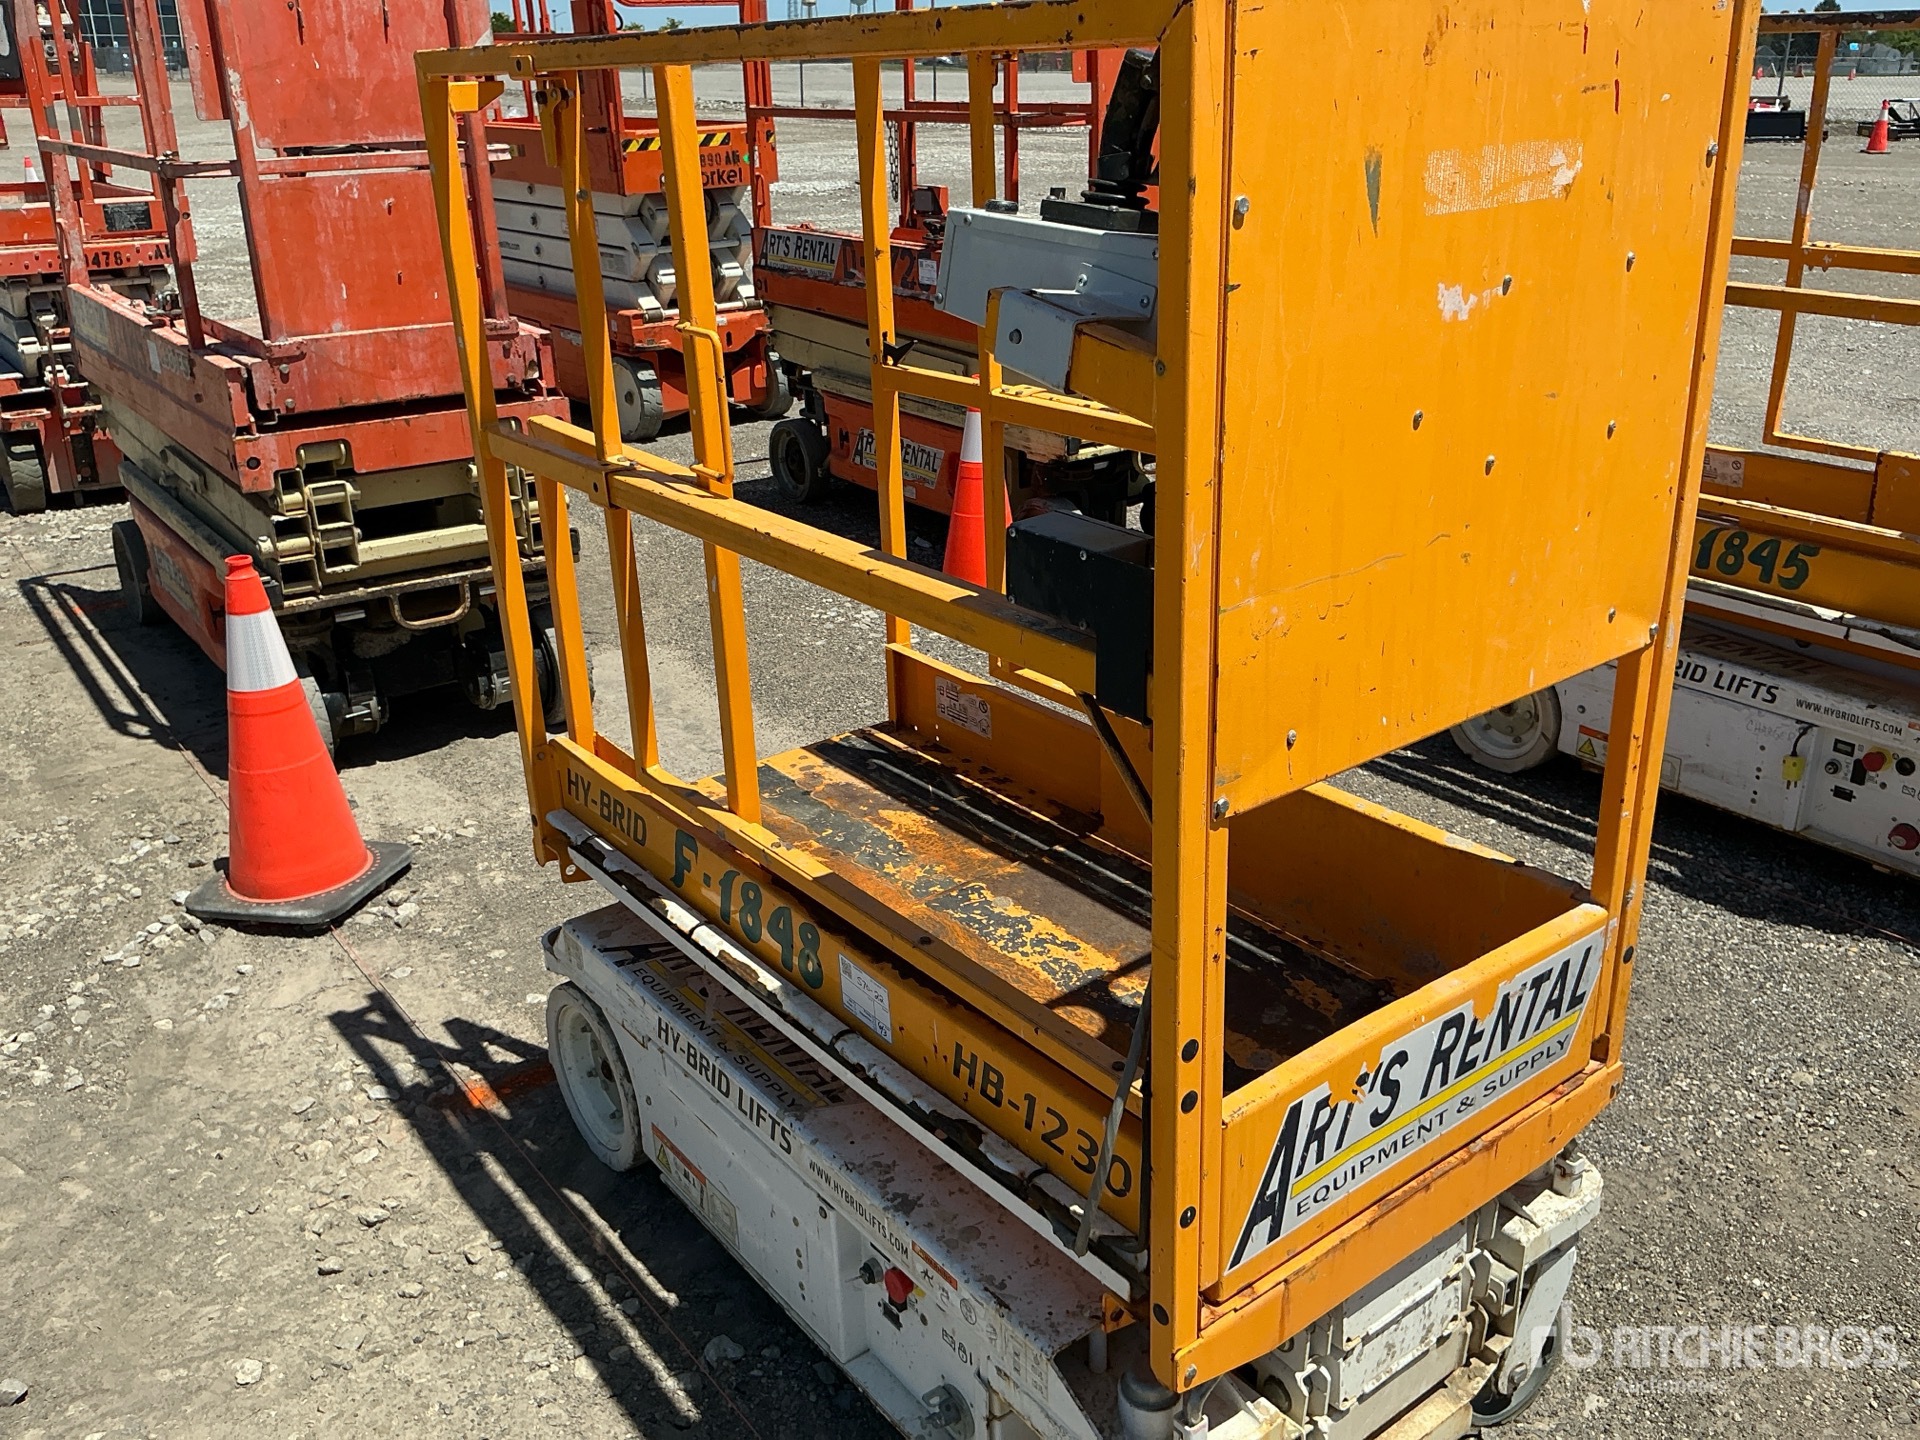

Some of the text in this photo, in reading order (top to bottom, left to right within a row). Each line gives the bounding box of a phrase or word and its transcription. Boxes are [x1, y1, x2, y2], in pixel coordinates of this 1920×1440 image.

[701, 167, 743, 186] orkel
[758, 229, 836, 267] ART'S RENTAL
[1695, 527, 1821, 590] 1845
[1713, 668, 1779, 704] LIFTS
[1796, 698, 1903, 736] WWW.HYBRIDLIFTS.COM
[567, 767, 647, 847] HY-BRID
[669, 828, 824, 989] F-1848
[632, 966, 723, 1038] EQUIPMENT
[733, 1055, 804, 1111] SUPPLY
[1419, 945, 1592, 1101] RENTAL
[656, 1016, 793, 1156] HY-BRID LIFTS
[953, 1041, 1132, 1198] HB-1230
[1296, 1034, 1569, 1217] EQUIPMENT & SUPPLY
[808, 1158, 909, 1261] WWW.HYBRIDLIFTS.COM
